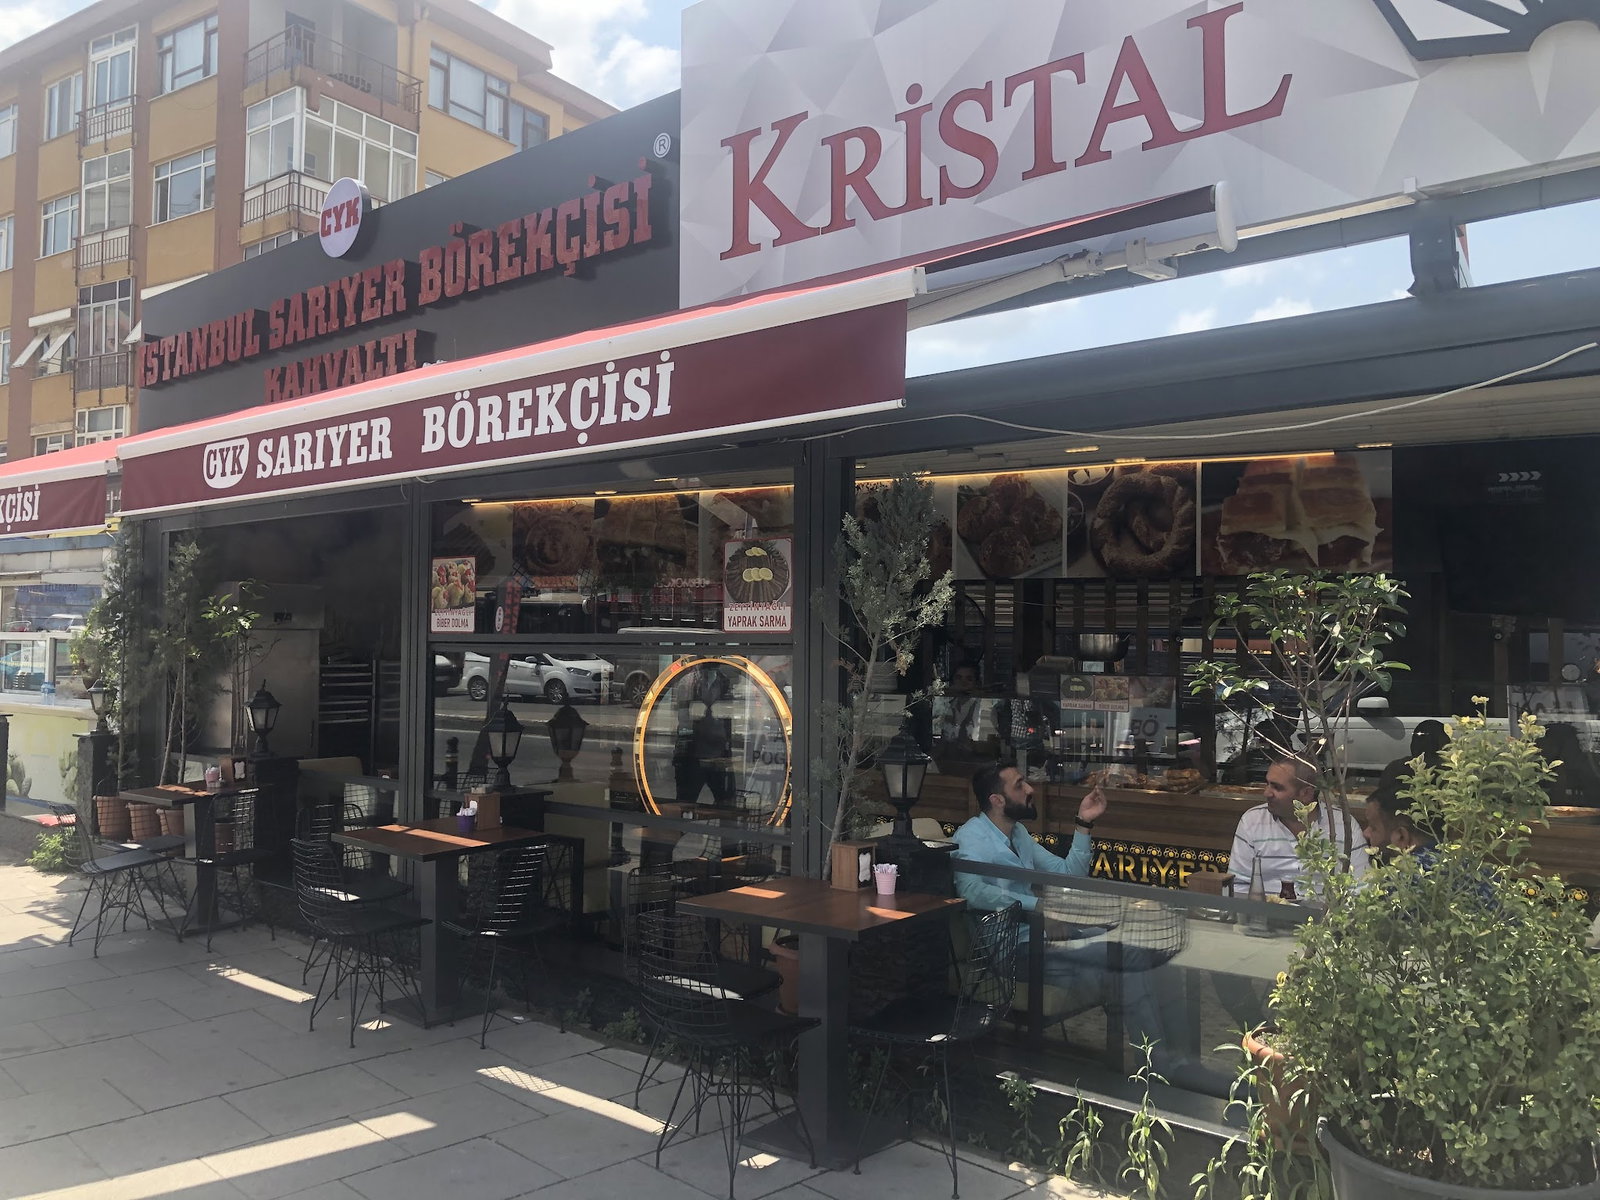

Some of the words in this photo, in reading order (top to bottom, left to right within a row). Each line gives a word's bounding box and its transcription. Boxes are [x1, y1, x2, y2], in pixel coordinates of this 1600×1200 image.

[720, 2, 1292, 261] KRİSTAL
[268, 258, 407, 350] SARIYER
[418, 156, 653, 307] BÖREKÇİSİ
[320, 196, 360, 238] CYK
[205, 444, 245, 480] CYK
[256, 416, 393, 480] SARIYER
[421, 350, 676, 446] BÖREKÇİSİ
[264, 329, 418, 404] KAHVALTI
[728, 615, 757, 627] YAPRAK
[759, 614, 787, 627] SARMA
